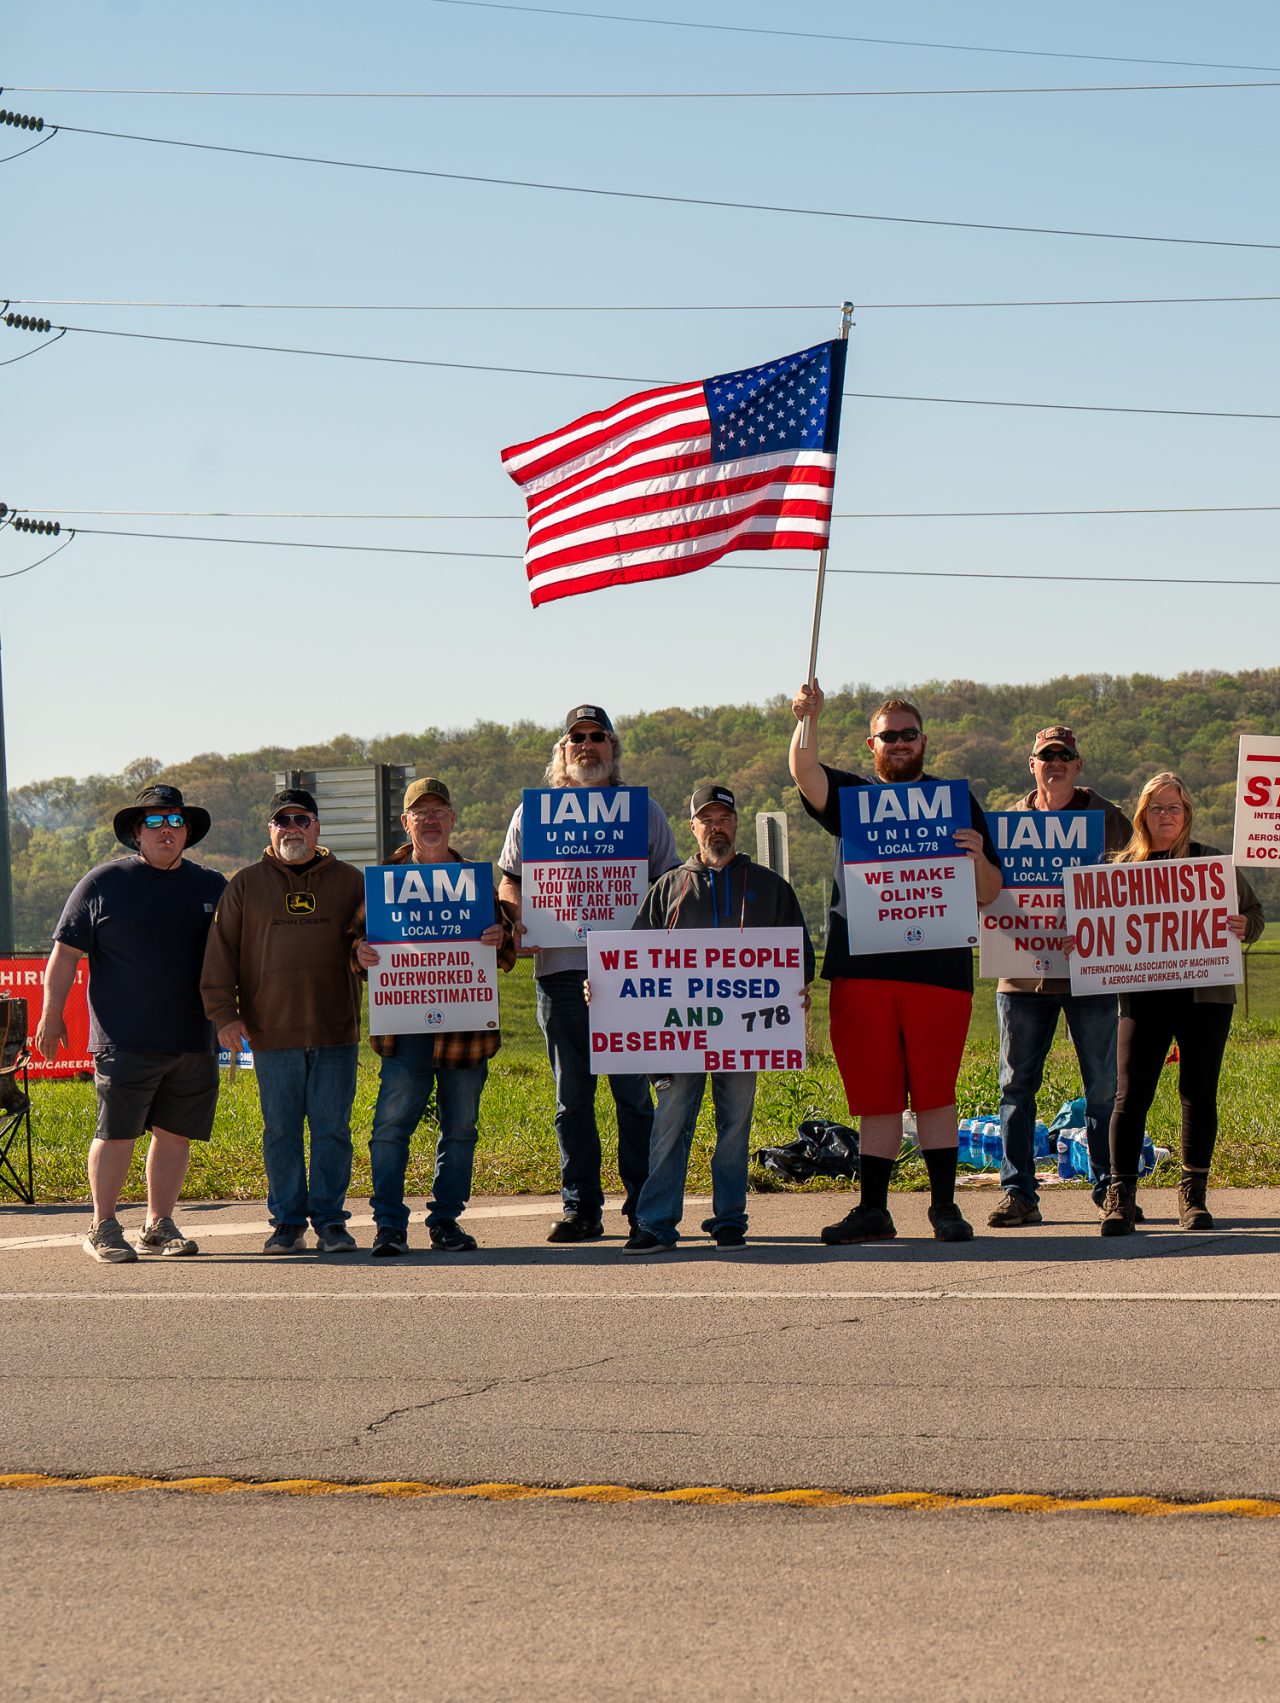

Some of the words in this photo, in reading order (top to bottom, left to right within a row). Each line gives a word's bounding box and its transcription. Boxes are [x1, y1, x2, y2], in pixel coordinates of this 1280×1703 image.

[541, 792, 629, 824] IAM
[859, 786, 952, 823] IAM
[547, 830, 623, 841] UNION
[868, 826, 947, 841] UNION
[998, 816, 1087, 849] IAM
[556, 845, 591, 854] LOCAL
[595, 845, 614, 853] 778
[879, 844, 915, 854] LOCAL
[918, 842, 938, 852] 778
[1004, 857, 1081, 867] UNION
[534, 868, 544, 880] IF
[548, 867, 582, 881] PIZZA
[586, 867, 598, 879] IS
[602, 865, 636, 879] WHAT
[865, 872, 894, 885] WE
[900, 866, 954, 882] MAKE
[1014, 872, 1049, 881] LOCAL
[1052, 872, 1063, 881] 77
[384, 869, 475, 904] IAM
[538, 881, 563, 894] YOU
[566, 880, 603, 893] WORK
[608, 879, 631, 893] FOR
[880, 886, 942, 902] OLIN'S
[1073, 861, 1226, 910] MACHINISTS
[532, 895, 562, 908] THEN
[566, 895, 583, 907] WE
[587, 894, 611, 907] ARE
[615, 893, 639, 906] NOT
[1018, 893, 1064, 908] FAIR
[392, 909, 470, 922] UNION
[555, 909, 577, 921] THE
[582, 907, 614, 920] SAME
[878, 904, 946, 921] PROFIT
[402, 926, 438, 936] LOCAL
[441, 925, 461, 934] 778
[1076, 916, 1115, 958] ON
[1125, 907, 1229, 956] STRIKE
[391, 951, 474, 969] UNDERPAID,
[600, 950, 638, 971] WE
[648, 948, 697, 969] THE
[705, 948, 799, 968] PEOPLE
[1080, 964, 1132, 975] INTERNATIONAL
[1133, 960, 1177, 971] ASSOCIATION
[1180, 960, 1189, 968] OF
[1189, 956, 1230, 967] MACHINISTS
[380, 968, 473, 987] OVERWORKED
[477, 968, 487, 984] &
[1102, 977, 1107, 985] &
[1108, 975, 1146, 984] AEROSPACE
[1147, 972, 1182, 982] WORKERS,
[1183, 970, 1209, 980] AFL-CIO
[374, 987, 492, 1006] UNDERESTIMATED
[620, 978, 672, 999] ARE
[688, 977, 780, 999] PISSED
[664, 1007, 723, 1027] AND
[741, 1005, 790, 1032] 778
[592, 1030, 707, 1052] DESERVE
[704, 1050, 802, 1070] BETTER
